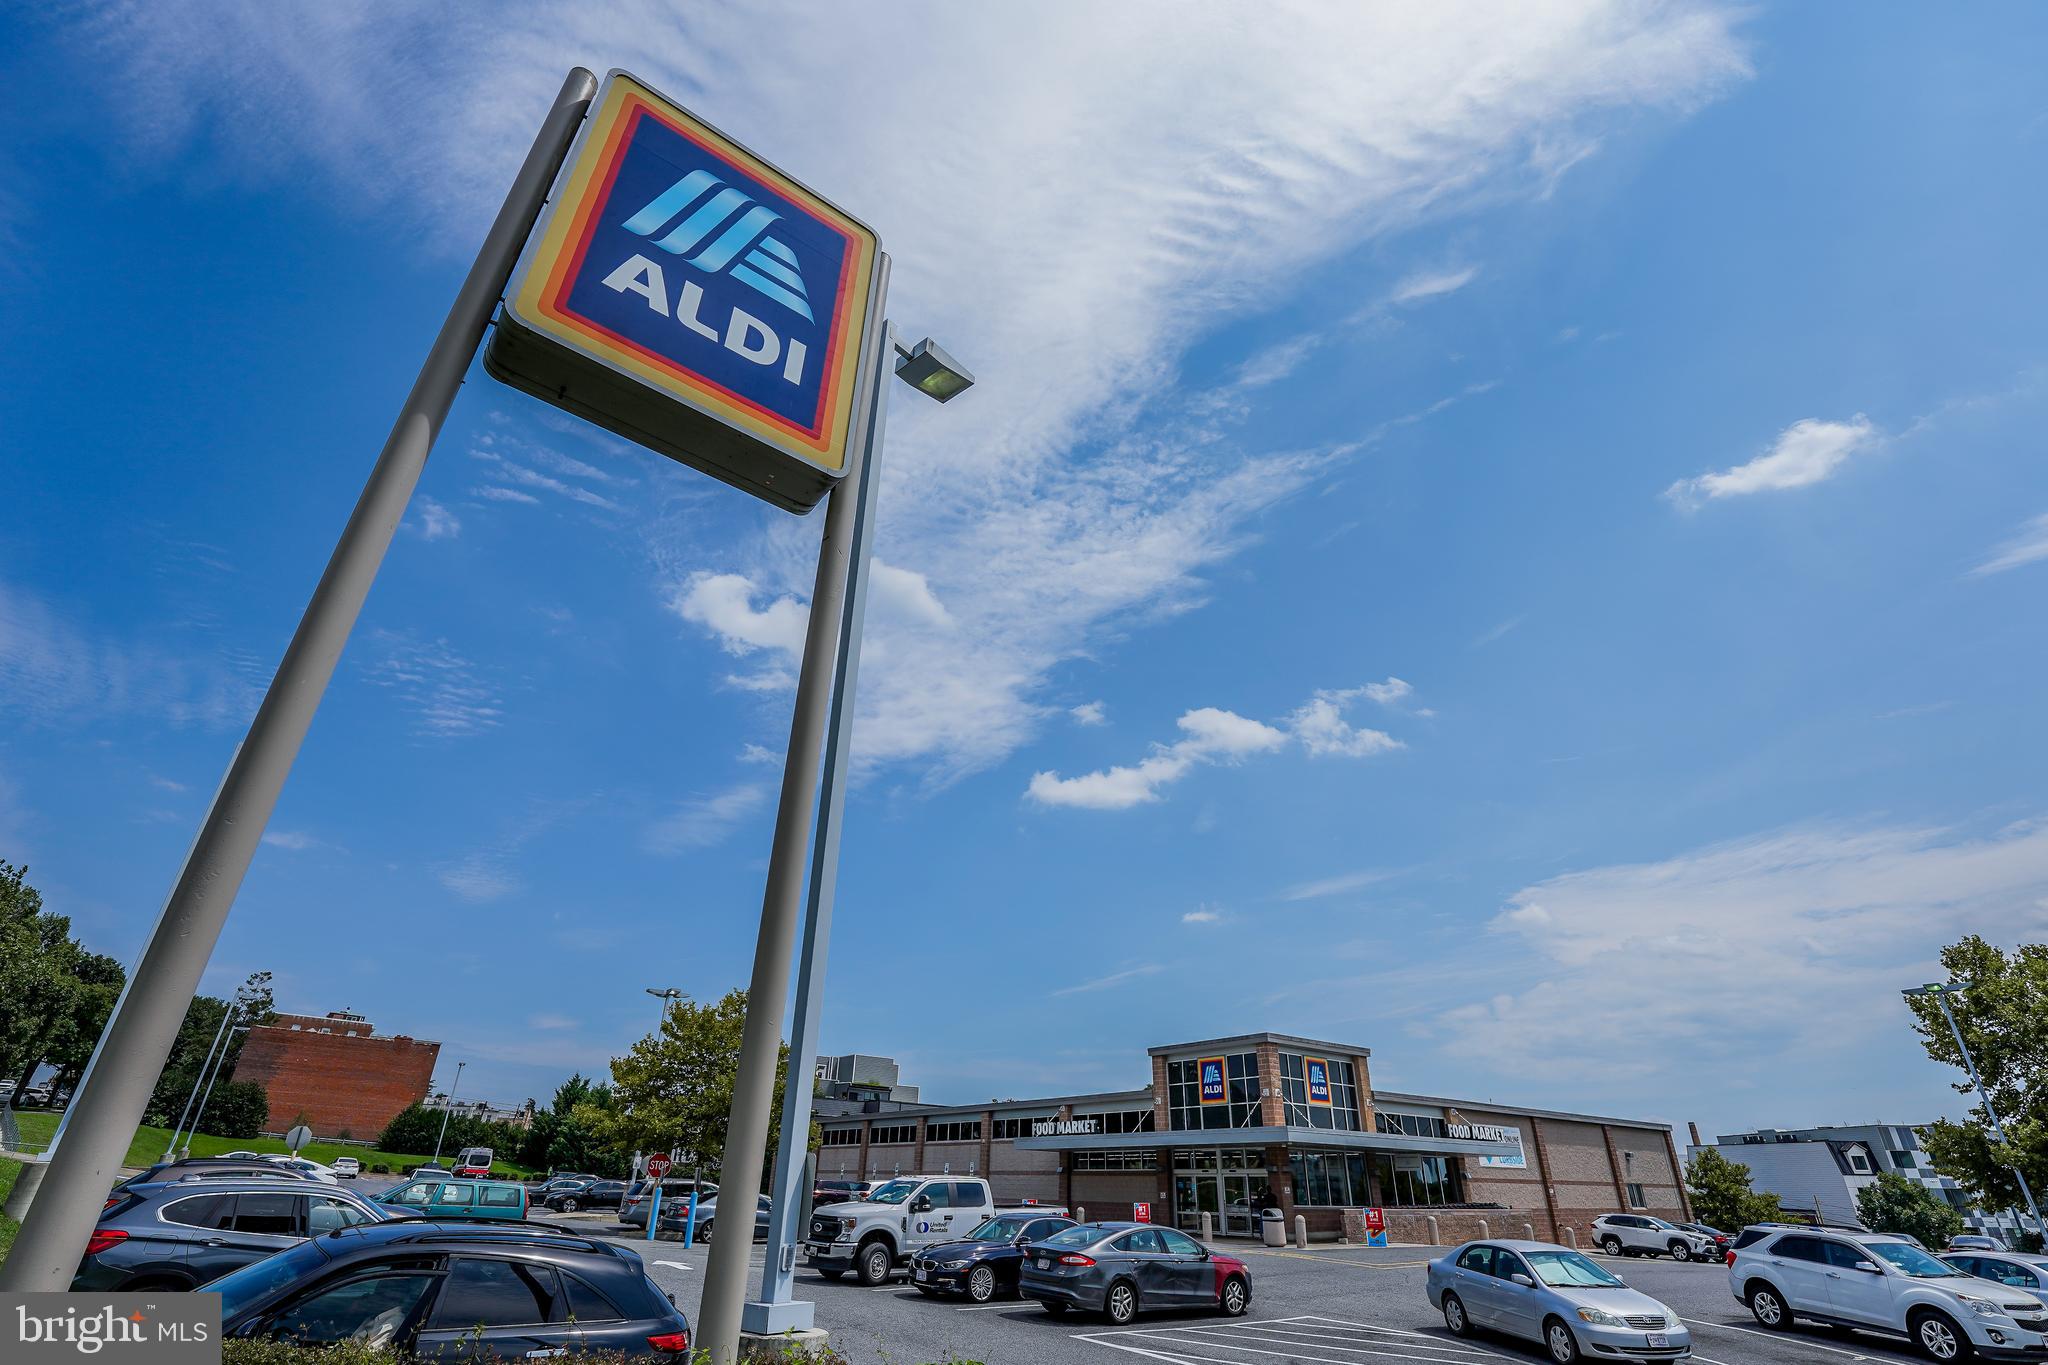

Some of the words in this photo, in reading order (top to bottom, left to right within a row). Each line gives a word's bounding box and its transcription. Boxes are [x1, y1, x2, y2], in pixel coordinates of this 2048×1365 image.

[601, 253, 807, 386] ALDI
[1204, 1085, 1222, 1094] ALDI
[1311, 1086, 1327, 1095] ALDI
[1032, 1121, 1055, 1136] FOOD
[1056, 1120, 1096, 1134] MARKET
[1448, 1124, 1471, 1138] FOOD
[1471, 1126, 1505, 1141] MARKET
[650, 1161, 669, 1169] STOP
